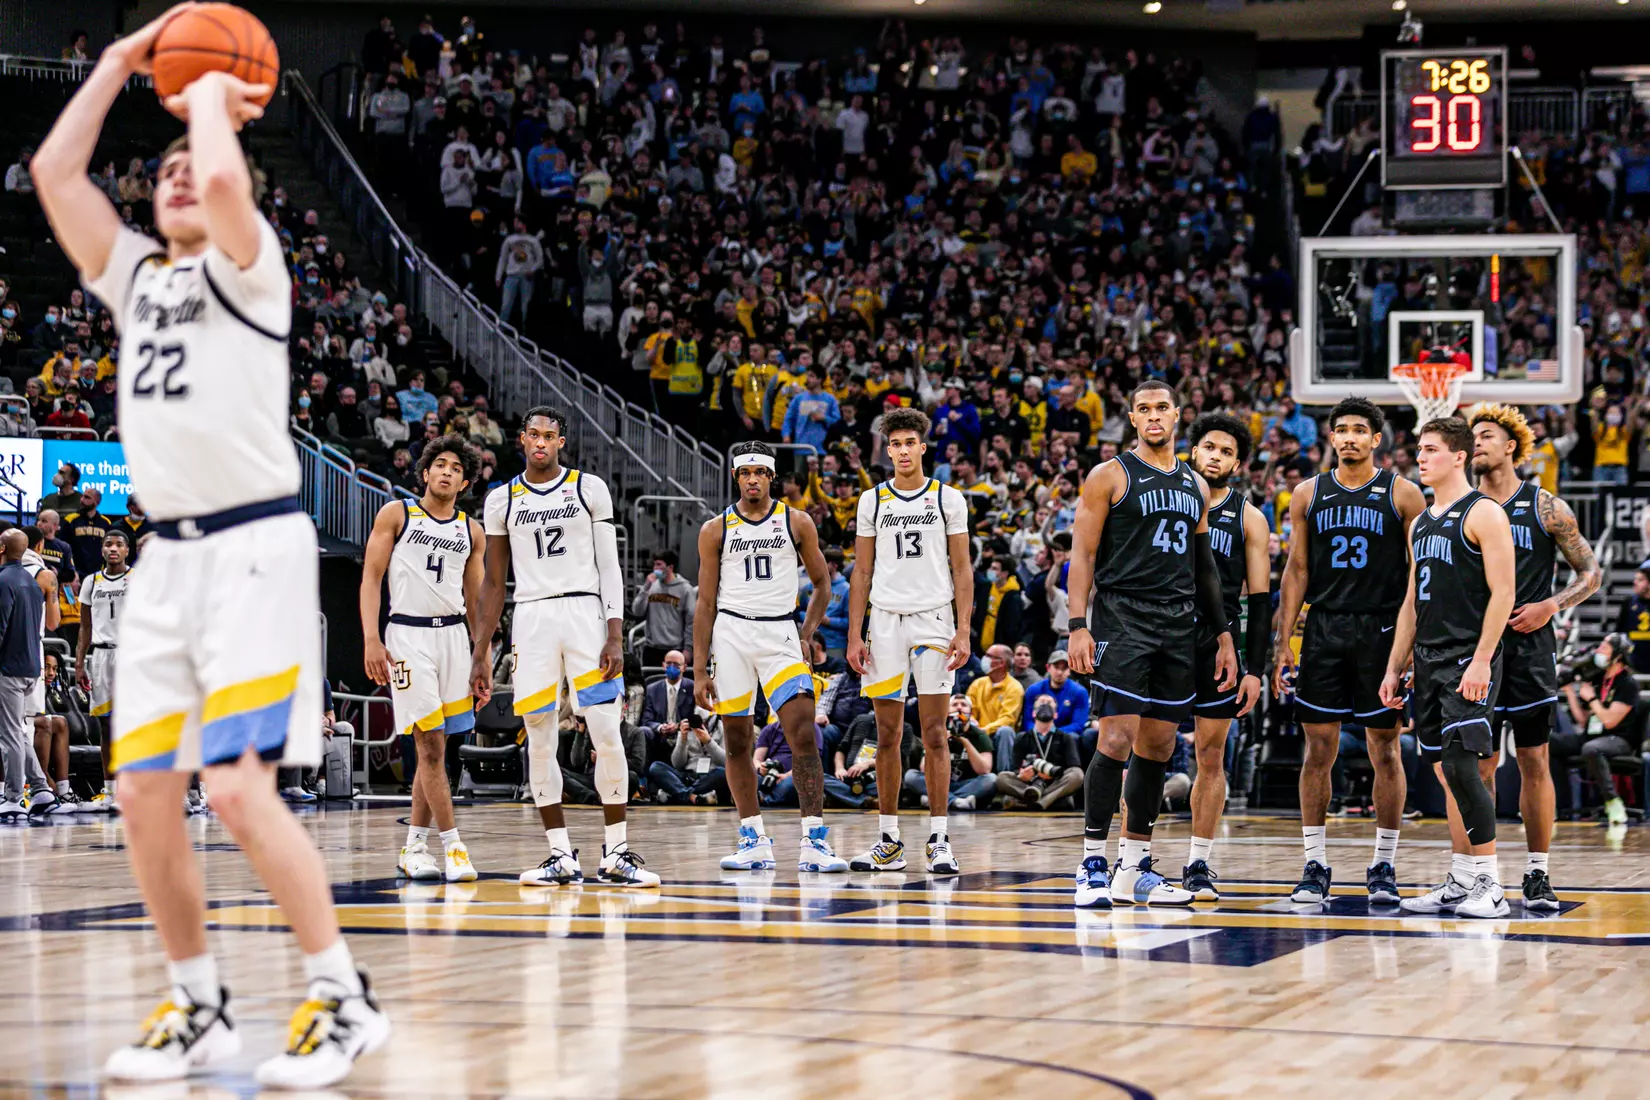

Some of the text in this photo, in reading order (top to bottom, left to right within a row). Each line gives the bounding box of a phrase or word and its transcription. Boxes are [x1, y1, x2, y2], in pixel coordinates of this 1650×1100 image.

[1421, 59, 1490, 94] 7:26
[1411, 94, 1481, 152] 30
[132, 340, 190, 400] 22
[514, 503, 580, 526] Marquette
[880, 511, 939, 530] Marquette
[1139, 489, 1200, 522] VILLANOVA
[1316, 505, 1384, 535] VILLANOVA
[406, 528, 468, 554] Marquette
[533, 525, 567, 559] 12
[729, 535, 787, 554] Marquette
[895, 530, 923, 559] 13
[1152, 519, 1188, 554] 43
[1331, 535, 1368, 569] 23
[426, 552, 446, 584] 4
[743, 553, 774, 582] 10
[1419, 565, 1431, 600] 2
[109, 600, 115, 620] 1
